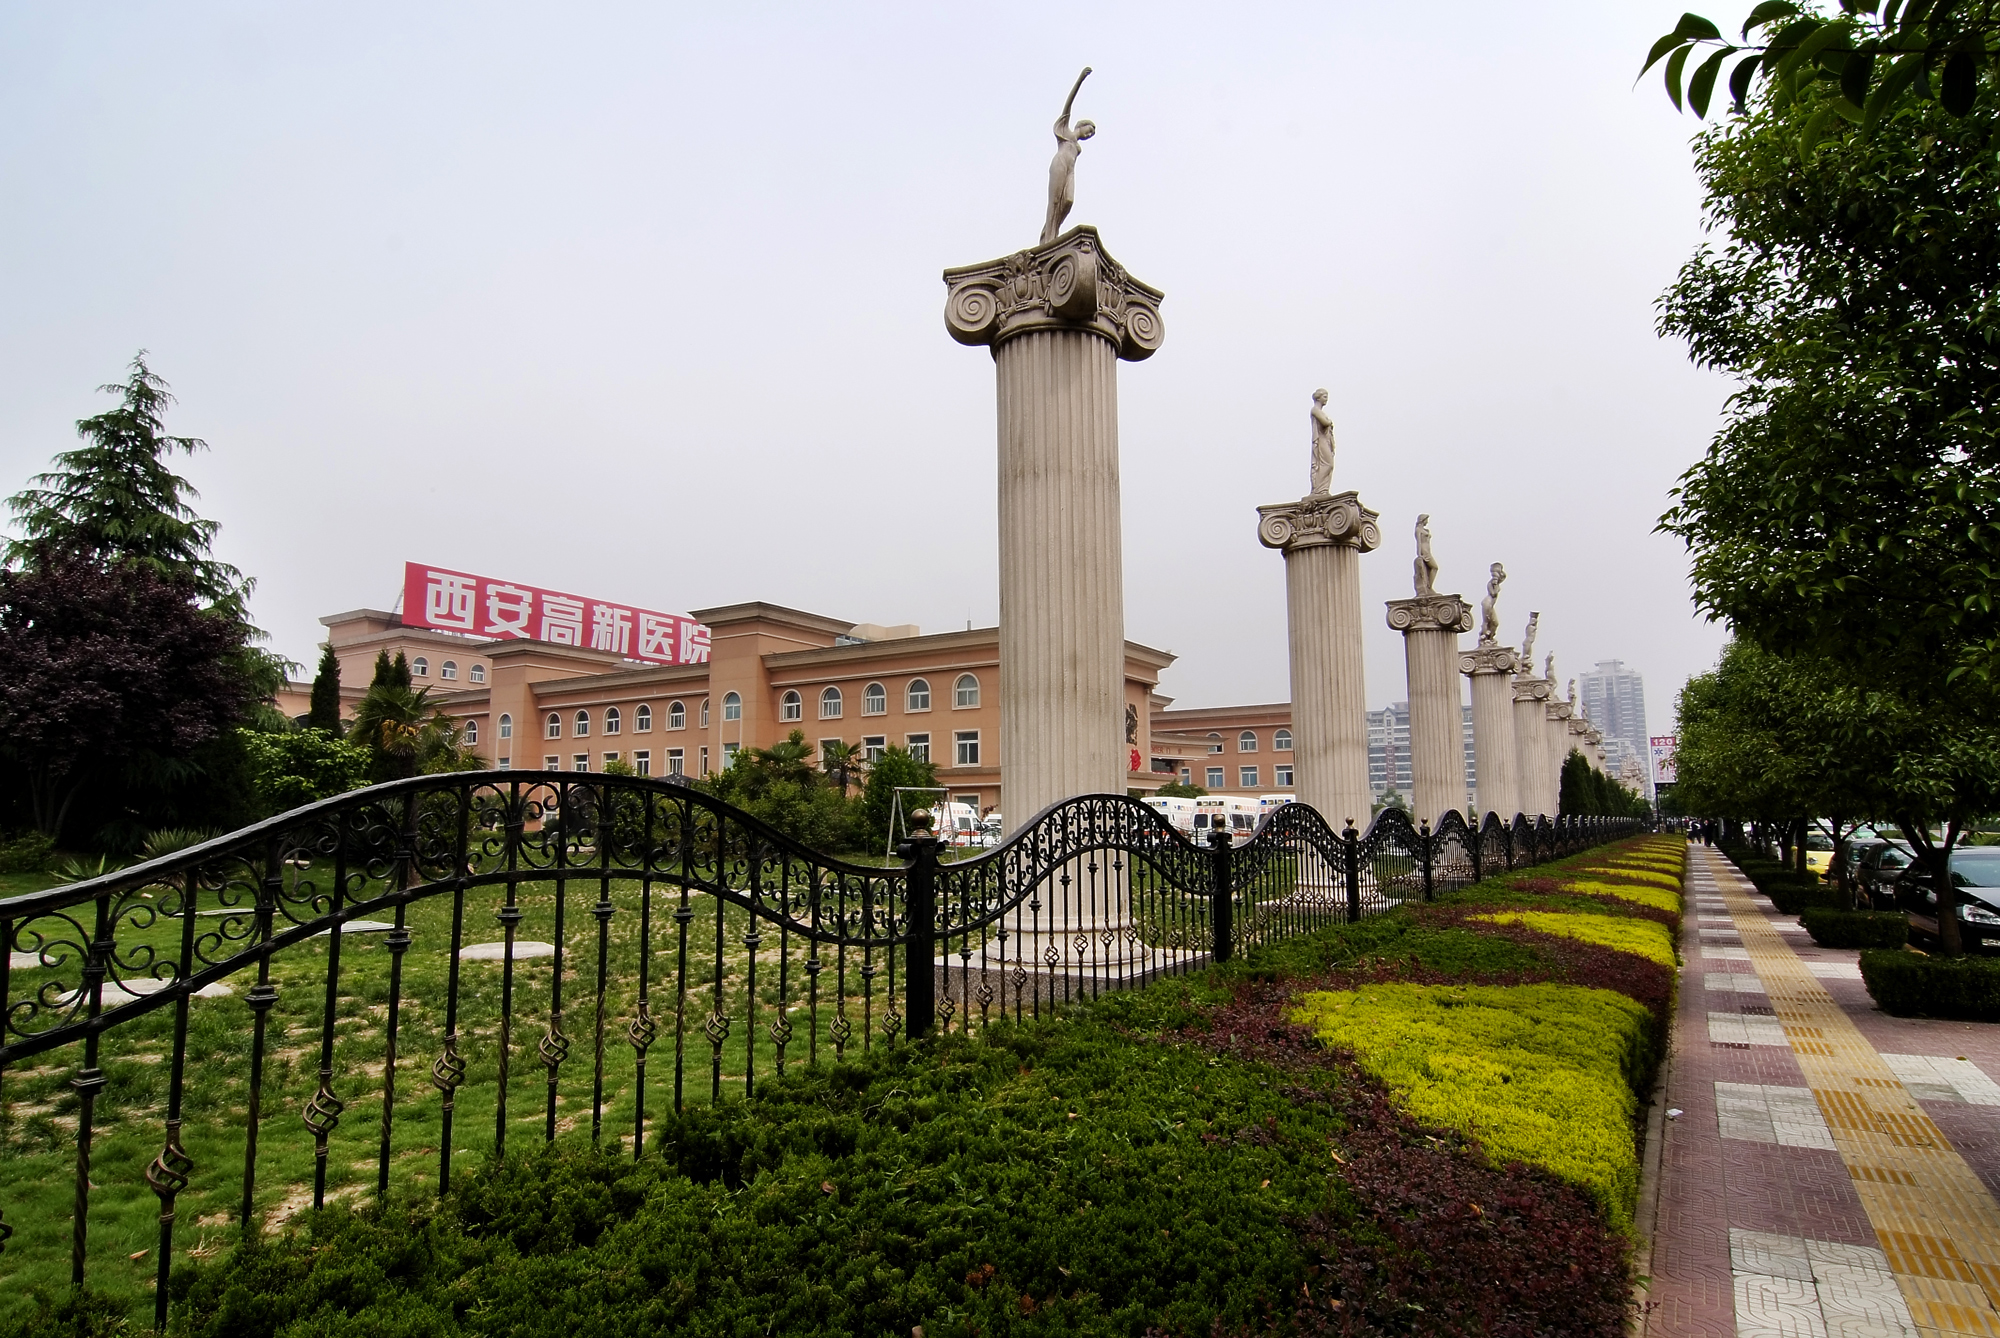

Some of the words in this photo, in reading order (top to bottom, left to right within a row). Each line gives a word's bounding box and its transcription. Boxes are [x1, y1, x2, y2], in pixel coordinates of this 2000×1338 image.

[426, 570, 711, 664] 西安高新医院
